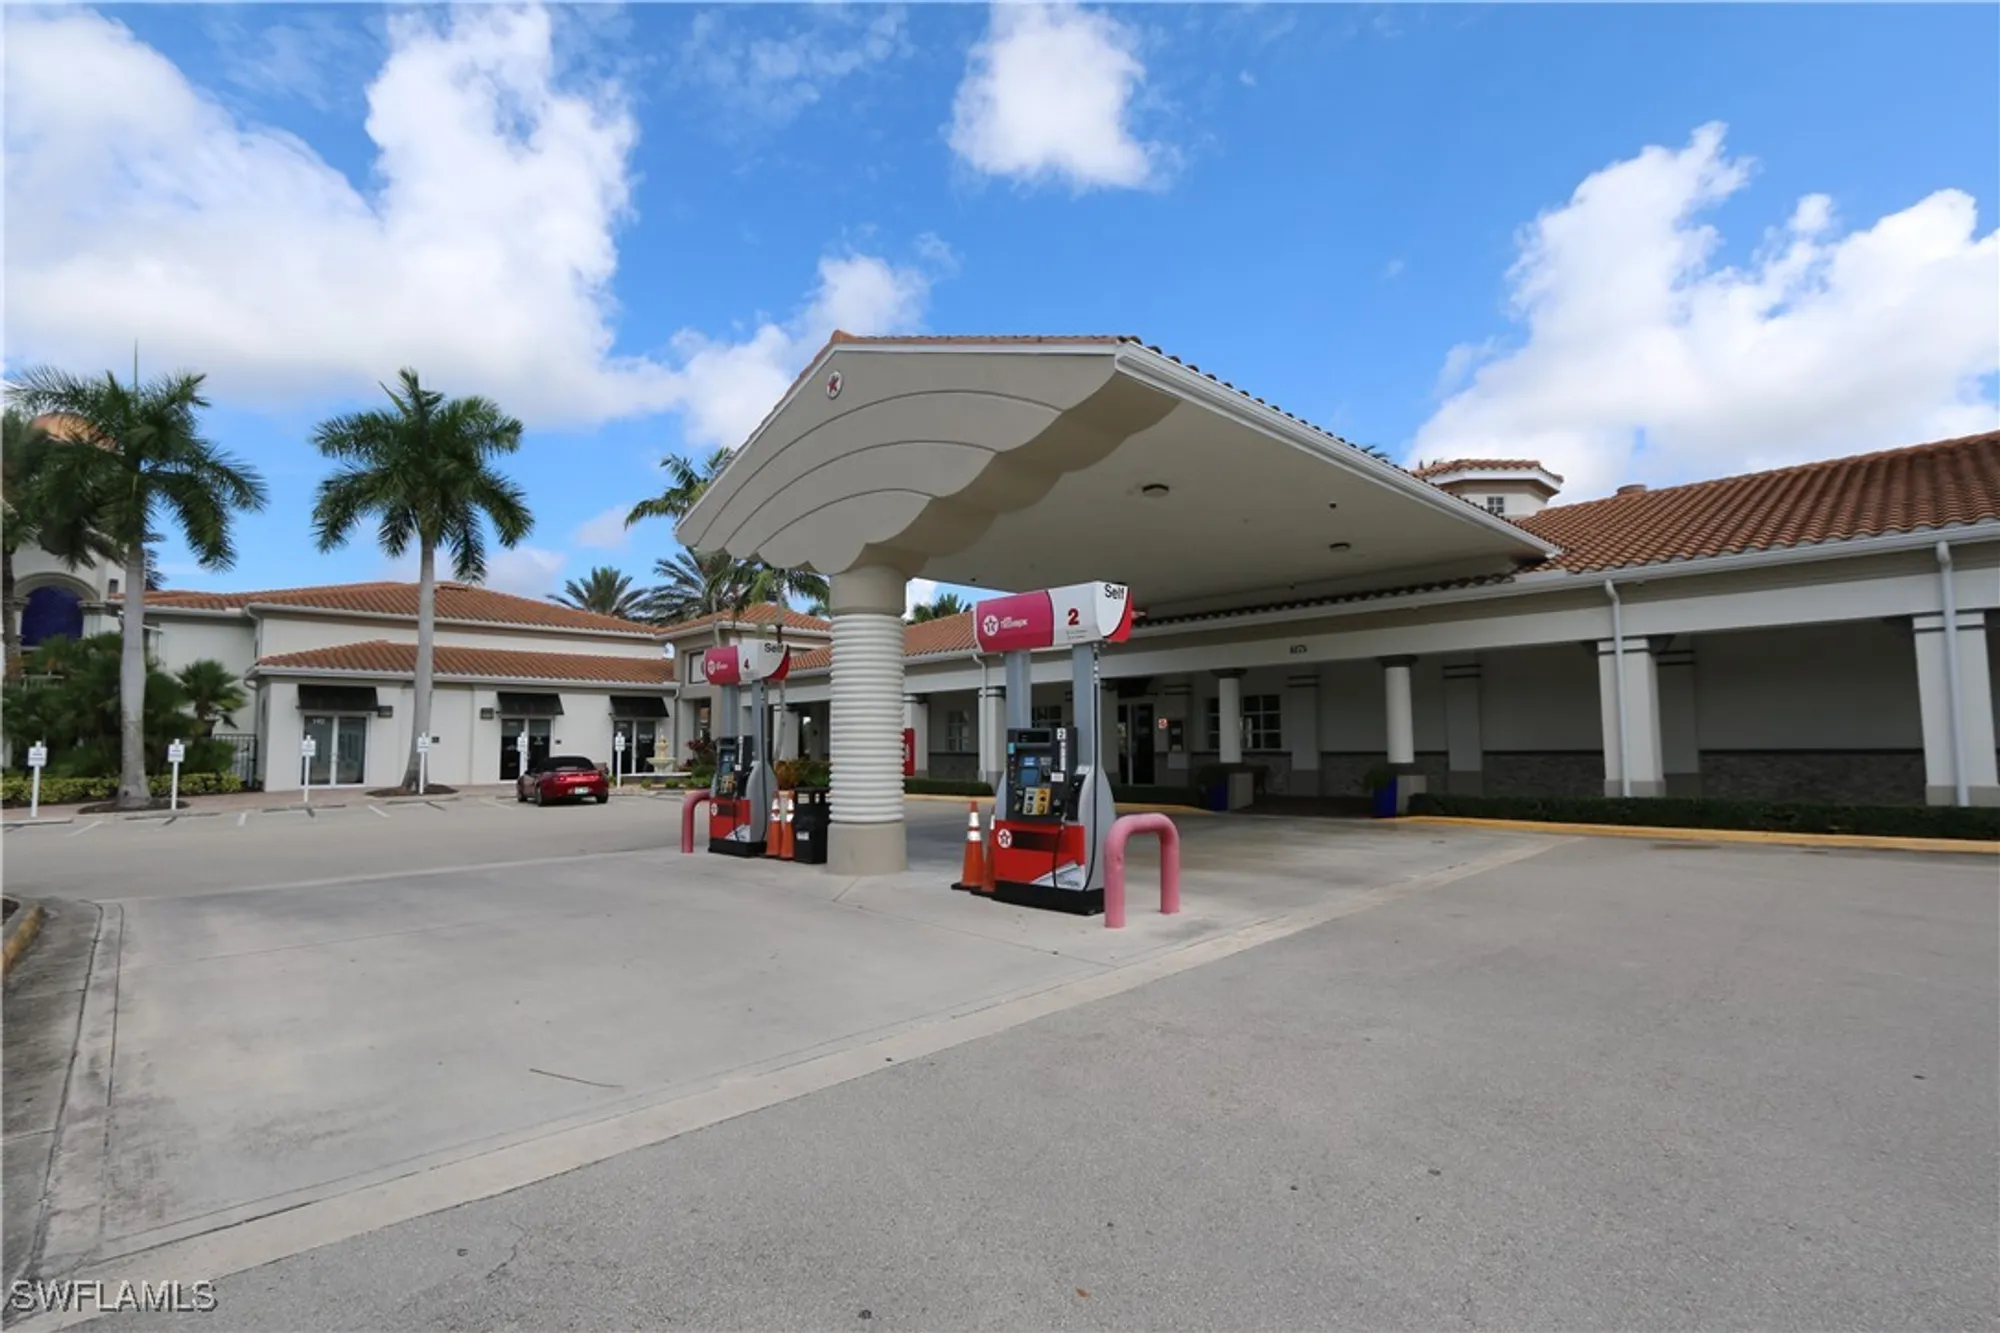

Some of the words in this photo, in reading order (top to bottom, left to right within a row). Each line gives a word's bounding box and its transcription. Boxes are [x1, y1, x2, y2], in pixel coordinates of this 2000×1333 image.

[1105, 584, 1124, 600] Self
[1068, 608, 1080, 625] 2
[764, 643, 784, 653] Self
[743, 658, 750, 669] 4
